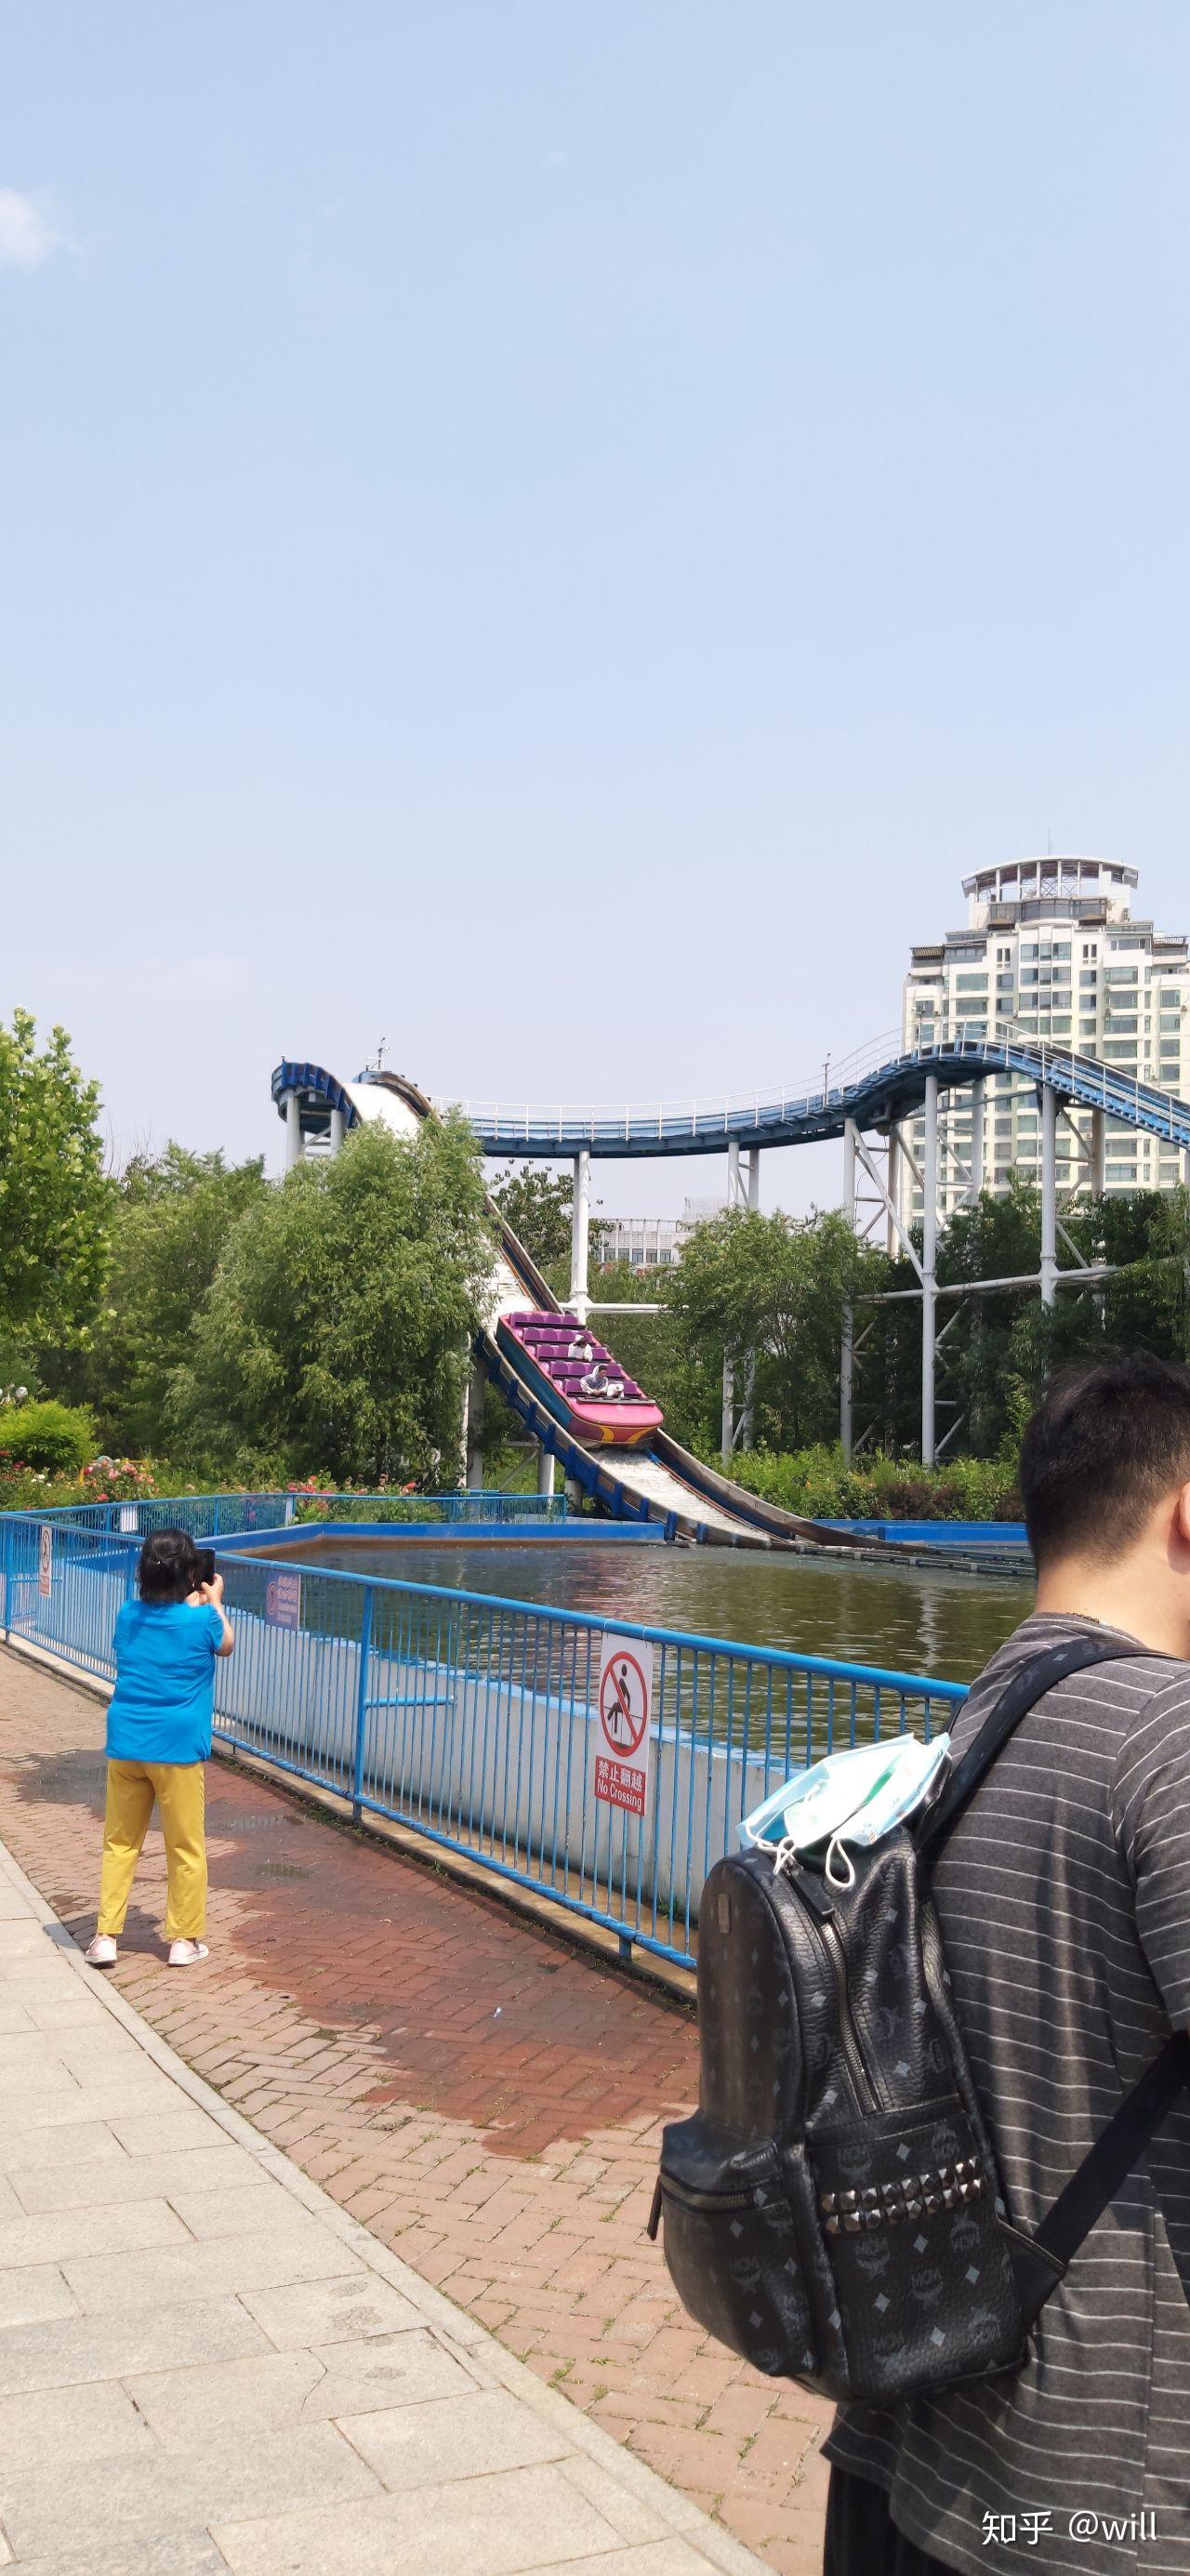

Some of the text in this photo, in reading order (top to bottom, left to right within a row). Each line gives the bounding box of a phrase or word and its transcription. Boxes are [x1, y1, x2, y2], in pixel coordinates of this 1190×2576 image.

[598, 1759, 642, 1792] 禁止翻越
[597, 1777, 641, 1812] No Crossing
